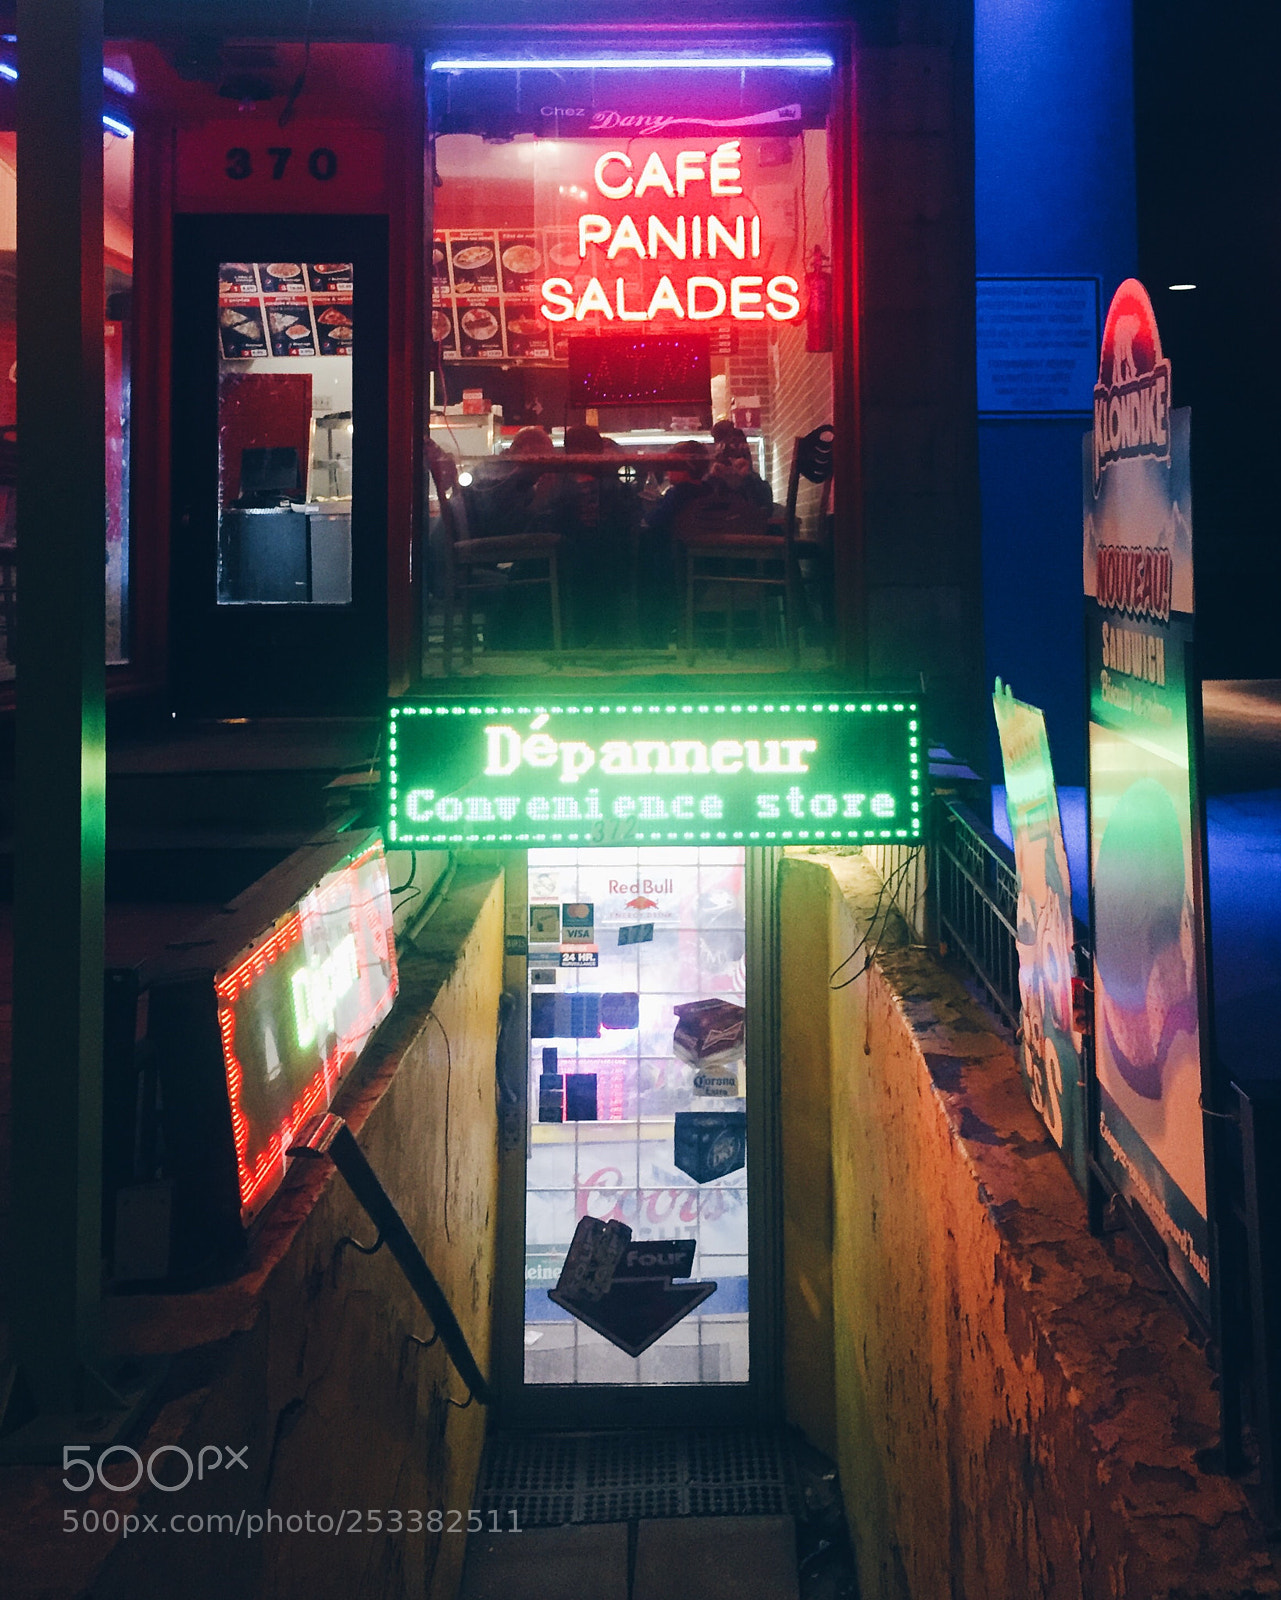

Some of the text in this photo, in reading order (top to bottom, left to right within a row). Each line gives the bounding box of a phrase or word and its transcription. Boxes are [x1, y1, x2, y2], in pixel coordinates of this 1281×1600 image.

[540, 105, 674, 135] Chez Dany
[225, 147, 338, 181] 370
[593, 140, 743, 199] CAFÉ
[578, 213, 761, 261] PANINI
[540, 274, 801, 322] SALADES
[1094, 376, 1167, 456] KLONDIKE
[1101, 620, 1165, 687] SANDWICH
[483, 713, 818, 783] Dépanneur
[405, 785, 897, 823] Convenience store
[608, 877, 673, 894] Red Bull
[566, 929, 590, 938] VISA
[562, 953, 576, 962] 24
[577, 953, 596, 962] HR.
[693, 1074, 736, 1089] Corona
